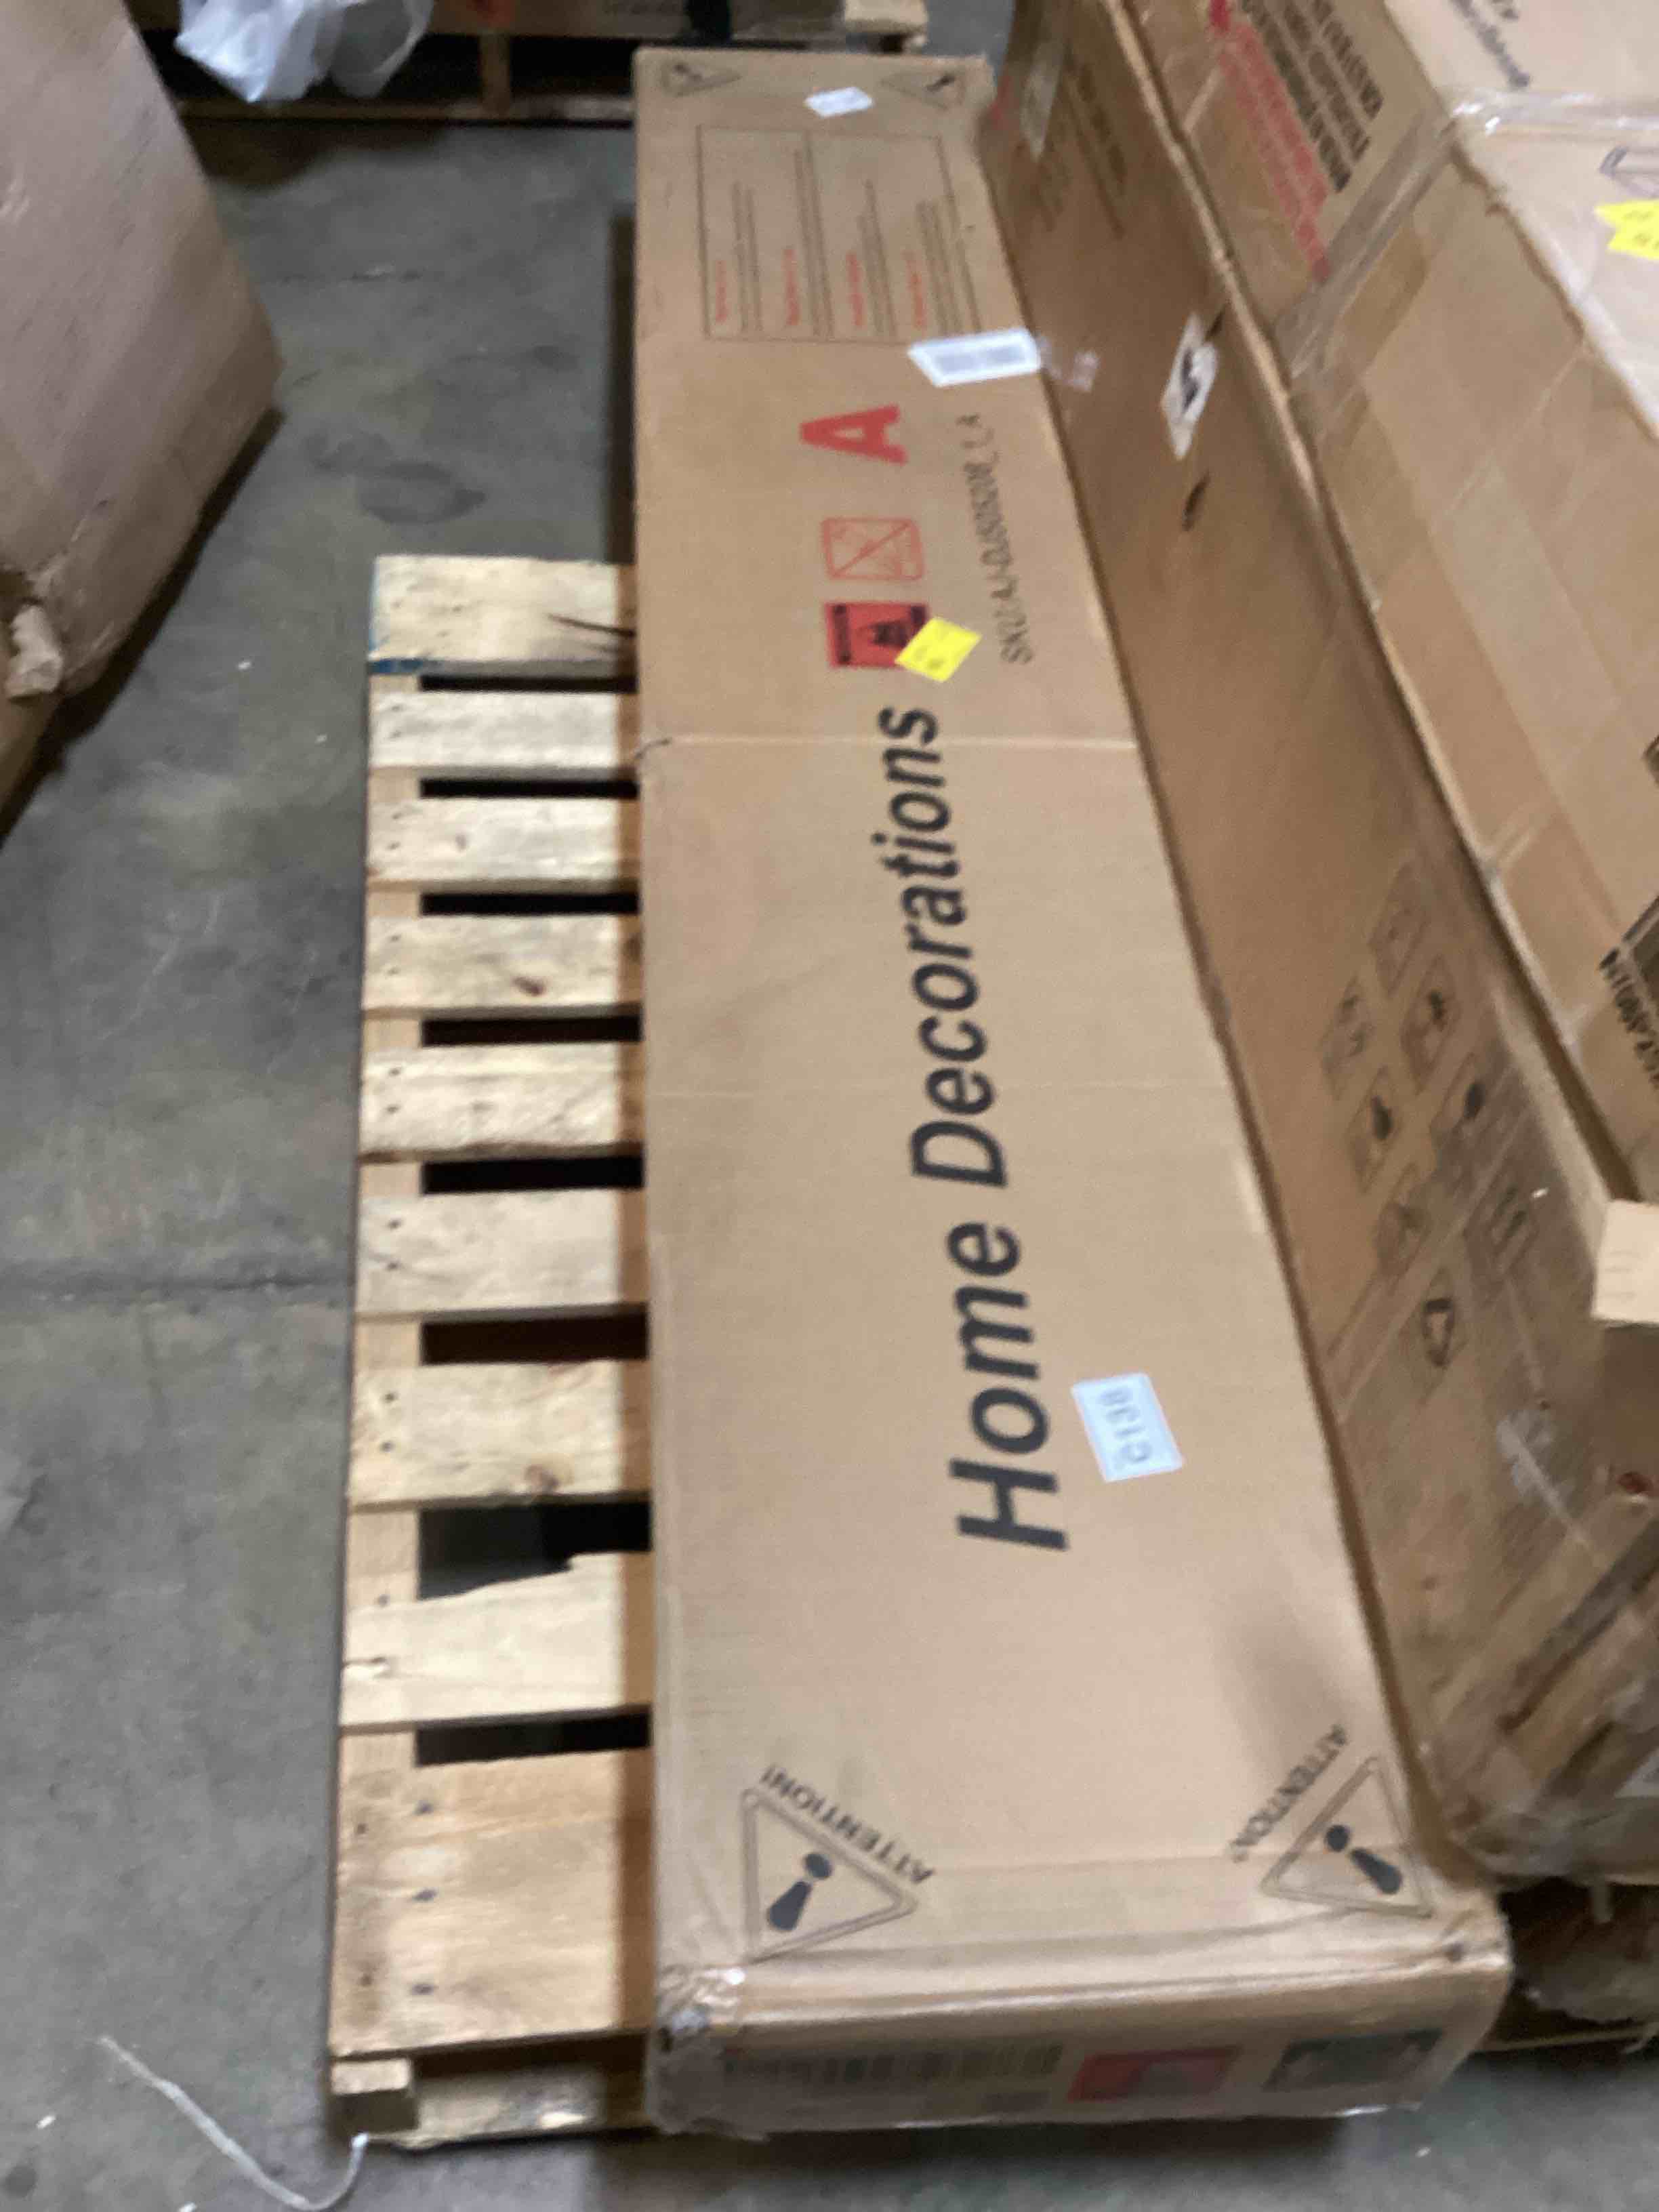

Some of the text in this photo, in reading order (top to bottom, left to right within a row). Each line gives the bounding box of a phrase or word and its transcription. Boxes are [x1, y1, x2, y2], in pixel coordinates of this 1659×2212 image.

[800, 405, 908, 466] A
[872, 707, 1069, 1552] Home Decorations
[759, 1764, 935, 1884] ATTENTION!
